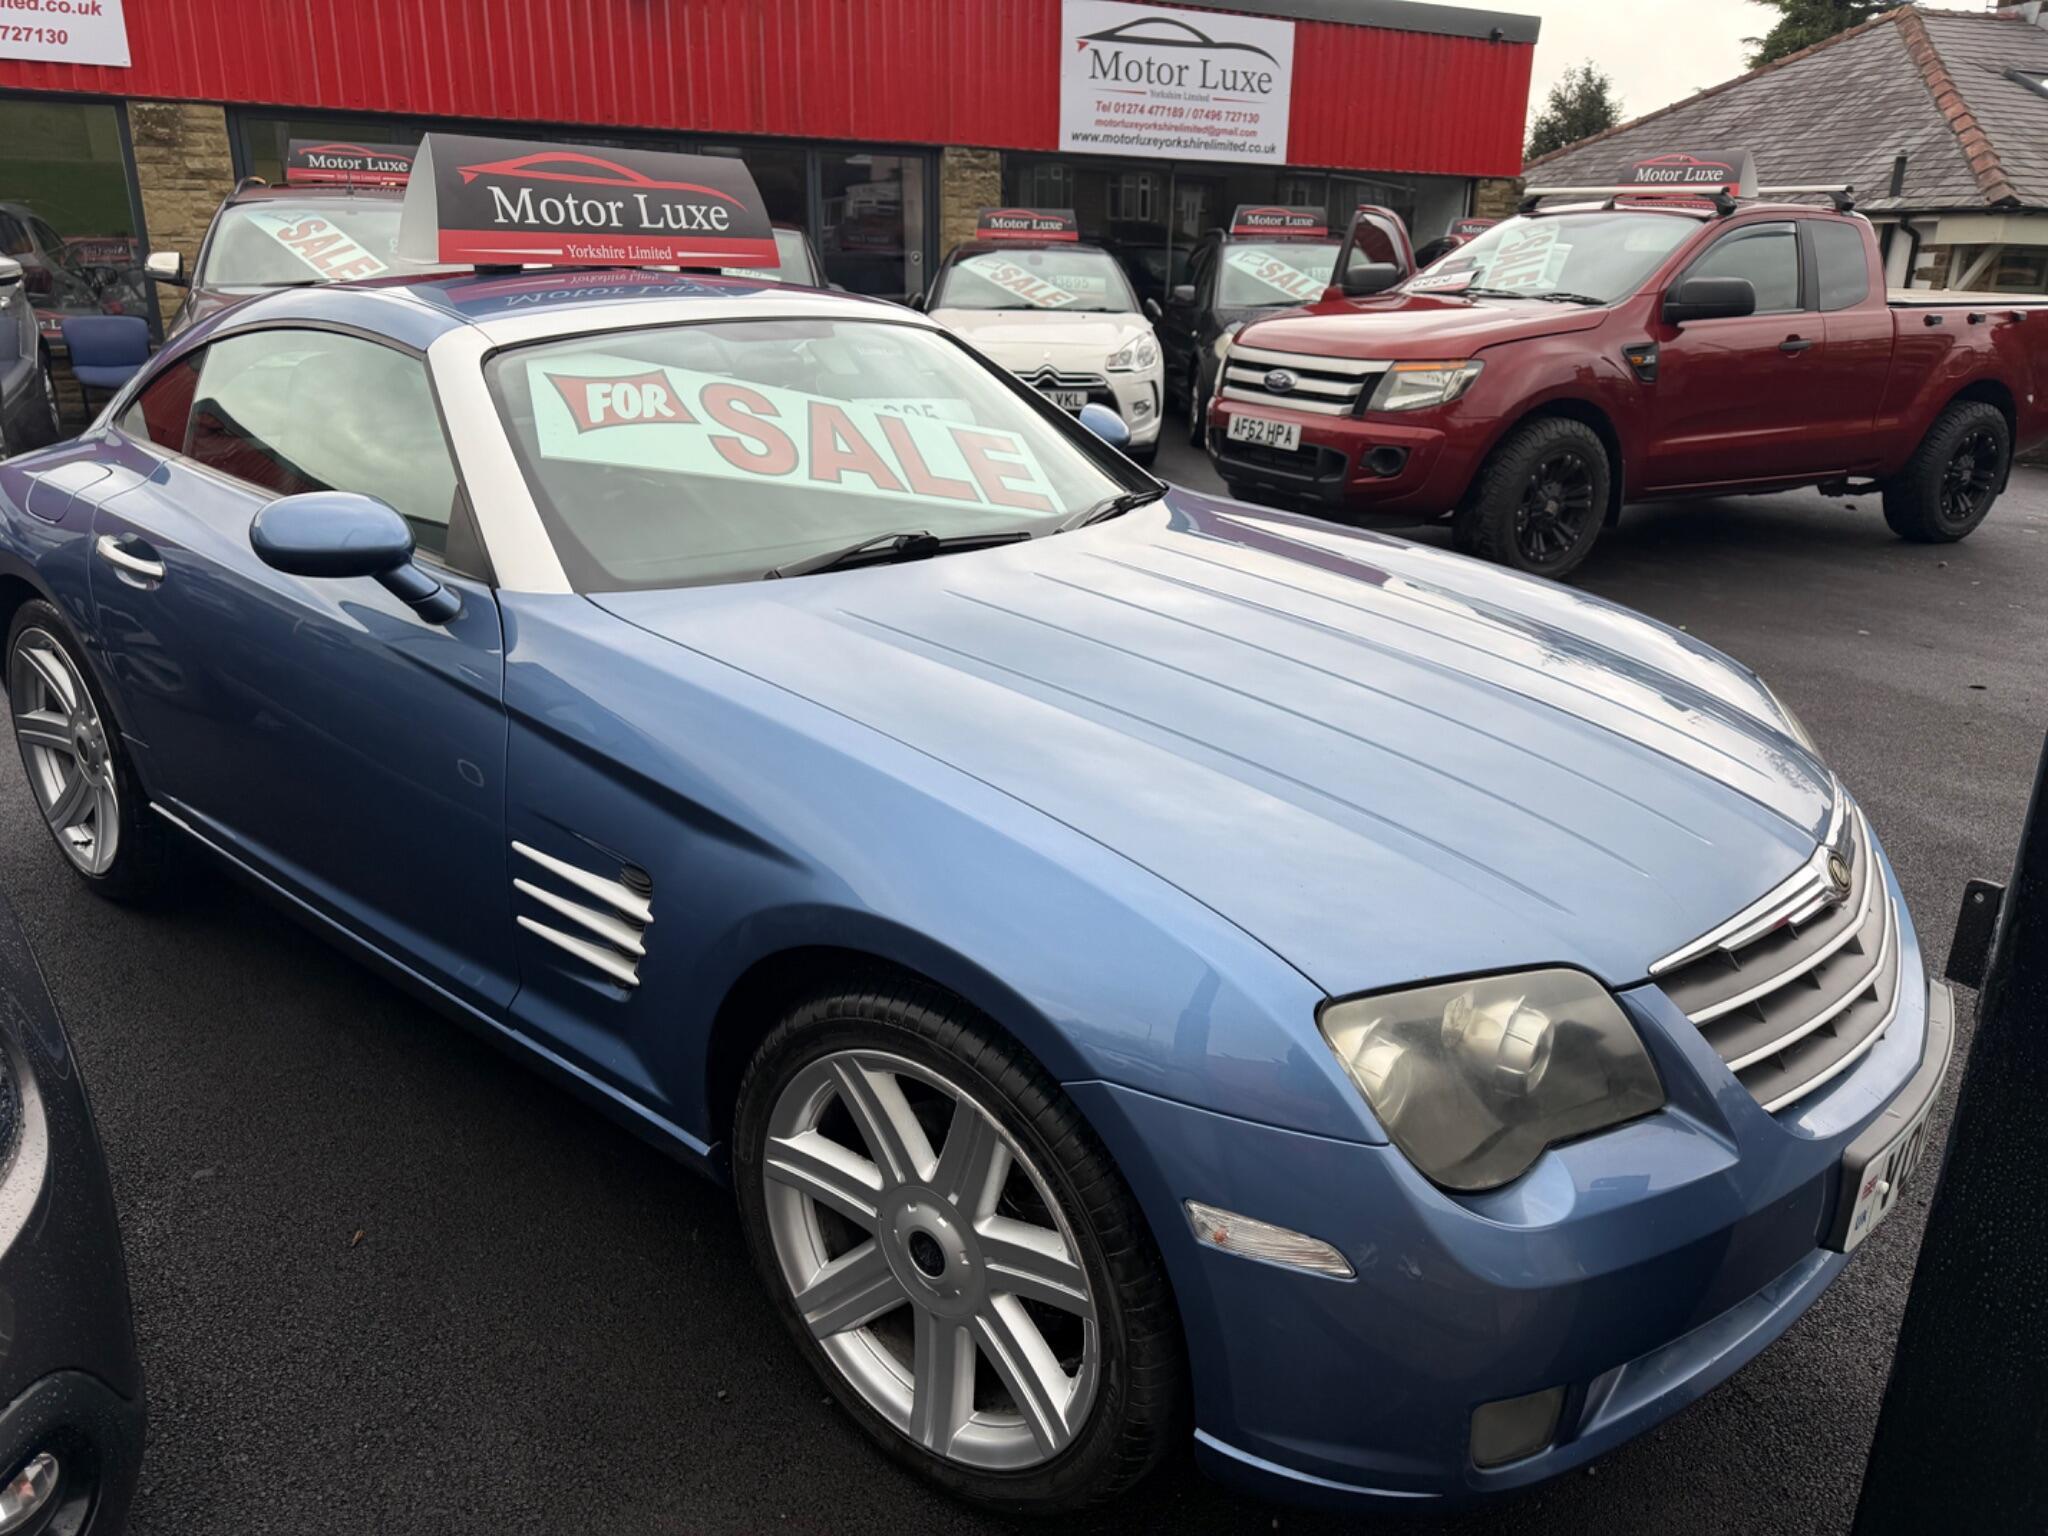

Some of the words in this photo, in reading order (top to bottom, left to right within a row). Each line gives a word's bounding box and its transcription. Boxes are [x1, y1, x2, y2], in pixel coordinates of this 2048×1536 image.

[0, 25, 69, 45] 727130
[1089, 48, 1189, 87] Motor
[1200, 58, 1272, 95] Luxe
[1096, 101, 1112, 113] Tel
[1114, 102, 1145, 115] 01274
[1148, 104, 1185, 117] 477189
[1225, 111, 1260, 124] 727130
[1094, 118, 1258, 137] motorluxeyorkshirelimited@gmail.com
[1072, 130, 1276, 154] www.motorluxeyorkshirelimited.co.uk
[307, 154, 362, 170] Motor
[366, 157, 408, 172] Luxe
[1634, 167, 1683, 183] Motor
[1683, 167, 1724, 182] Luxe
[487, 185, 624, 227] Motor
[634, 193, 730, 232] Luxe
[991, 217, 1030, 229] Motor
[1032, 219, 1063, 231] Luxe
[1247, 214, 1283, 226] Motor
[1285, 215, 1314, 227] Luxe
[277, 218, 382, 281] SALE
[567, 244, 625, 260] Yorkshire
[628, 246, 672, 261] Limited
[1487, 236, 1552, 291] SALE
[989, 266, 1071, 307] SALE
[1233, 417, 1265, 440] AF62
[1266, 422, 1292, 445] HPA
[585, 382, 675, 423] FOR
[699, 382, 1060, 514] SALE
